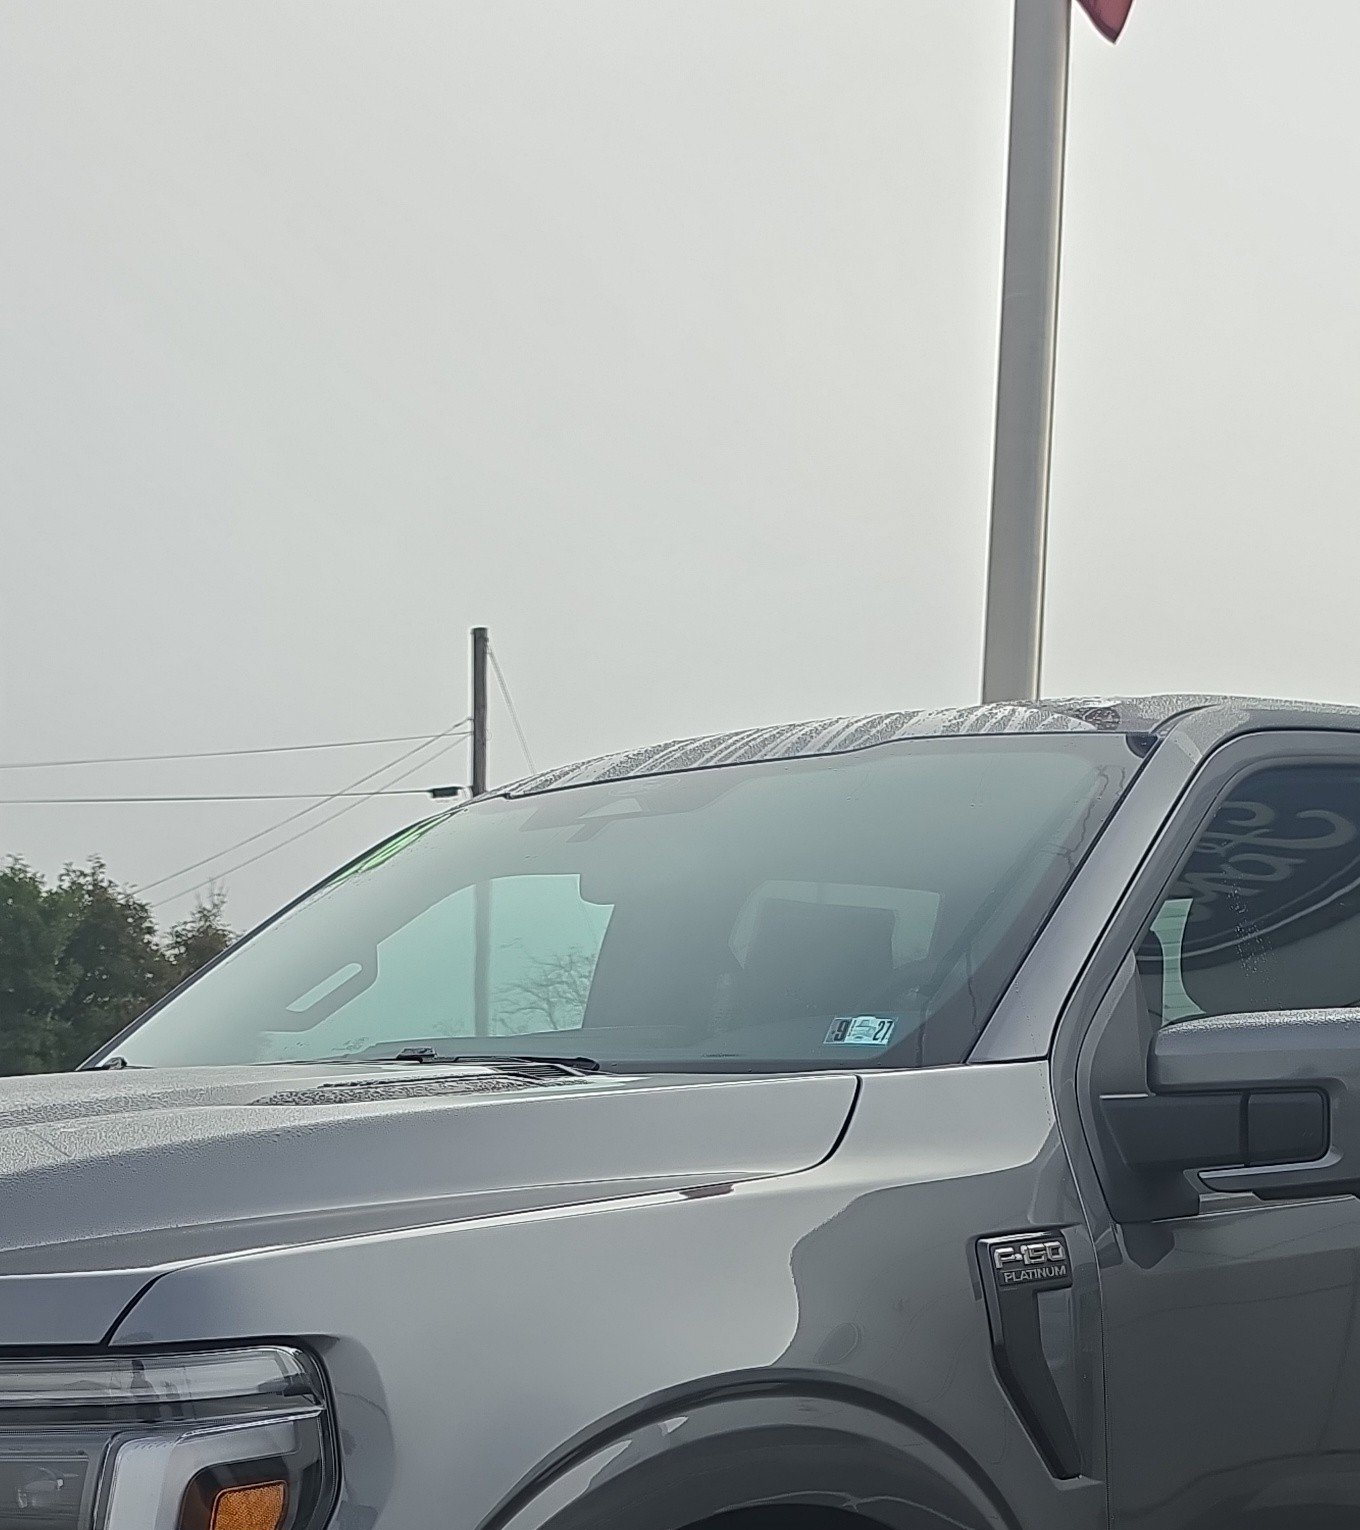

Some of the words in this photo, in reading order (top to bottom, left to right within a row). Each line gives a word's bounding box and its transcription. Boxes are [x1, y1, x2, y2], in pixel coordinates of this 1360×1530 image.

[833, 1020, 850, 1042] 9
[872, 1020, 894, 1042] 27
[994, 1242, 1066, 1268] F-150
[1004, 1266, 1066, 1283] PLATINUM
